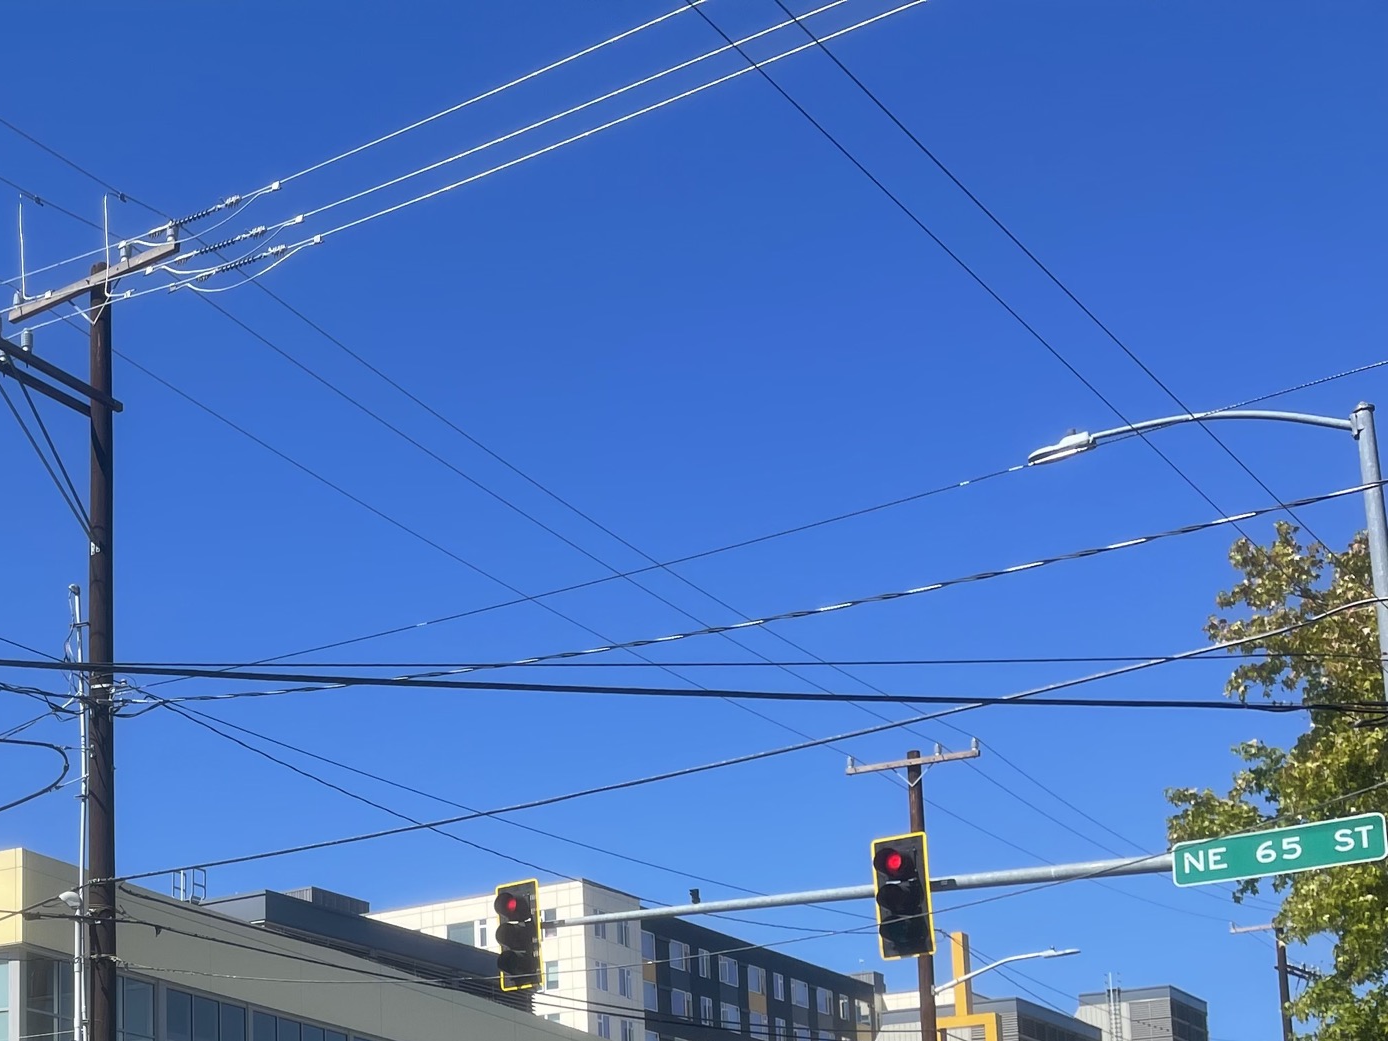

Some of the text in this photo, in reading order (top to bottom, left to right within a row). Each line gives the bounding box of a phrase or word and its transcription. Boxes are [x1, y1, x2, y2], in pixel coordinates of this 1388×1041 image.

[1183, 824, 1374, 874] NE 65 ST
